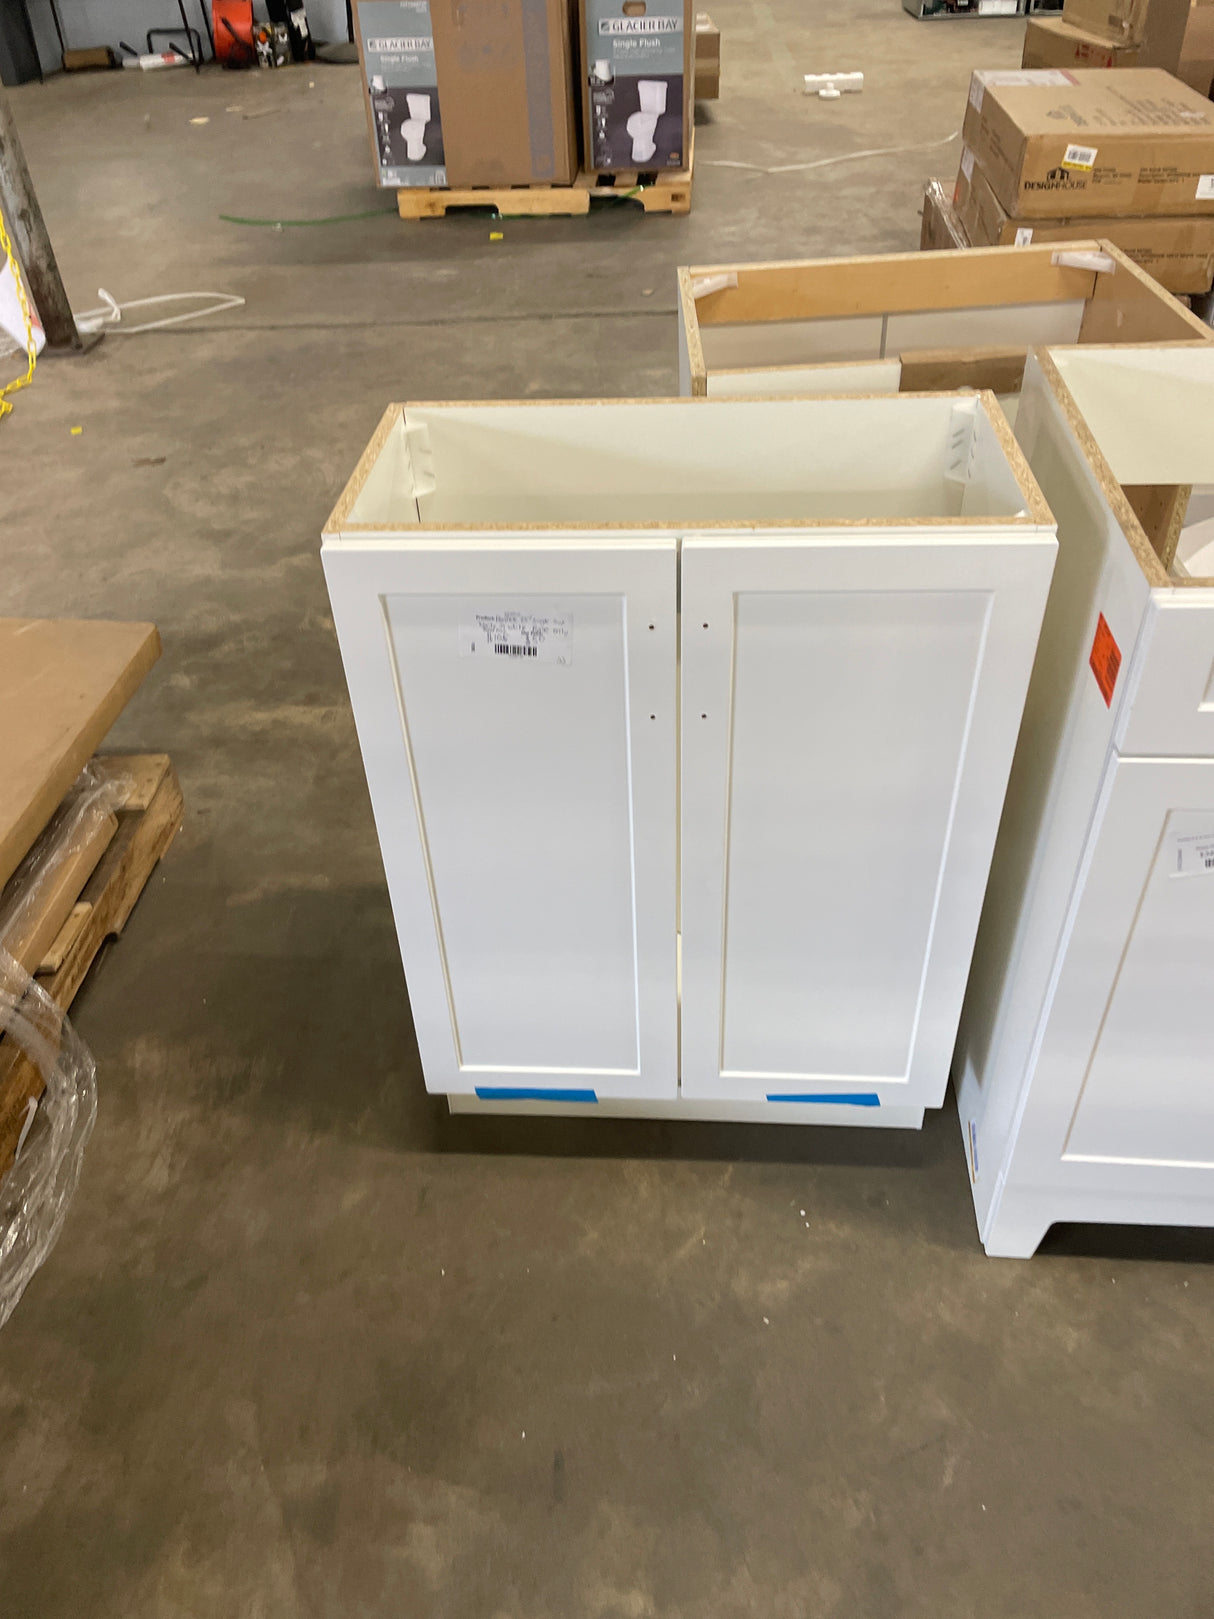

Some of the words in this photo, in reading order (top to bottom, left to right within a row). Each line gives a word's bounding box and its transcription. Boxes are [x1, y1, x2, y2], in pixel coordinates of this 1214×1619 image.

[613, 20, 655, 31] GLACIER
[658, 19, 677, 30] BAY
[379, 39, 413, 49] GLACIER
[415, 38, 431, 48] BAY
[613, 38, 637, 49] Single
[640, 38, 661, 47] Flush
